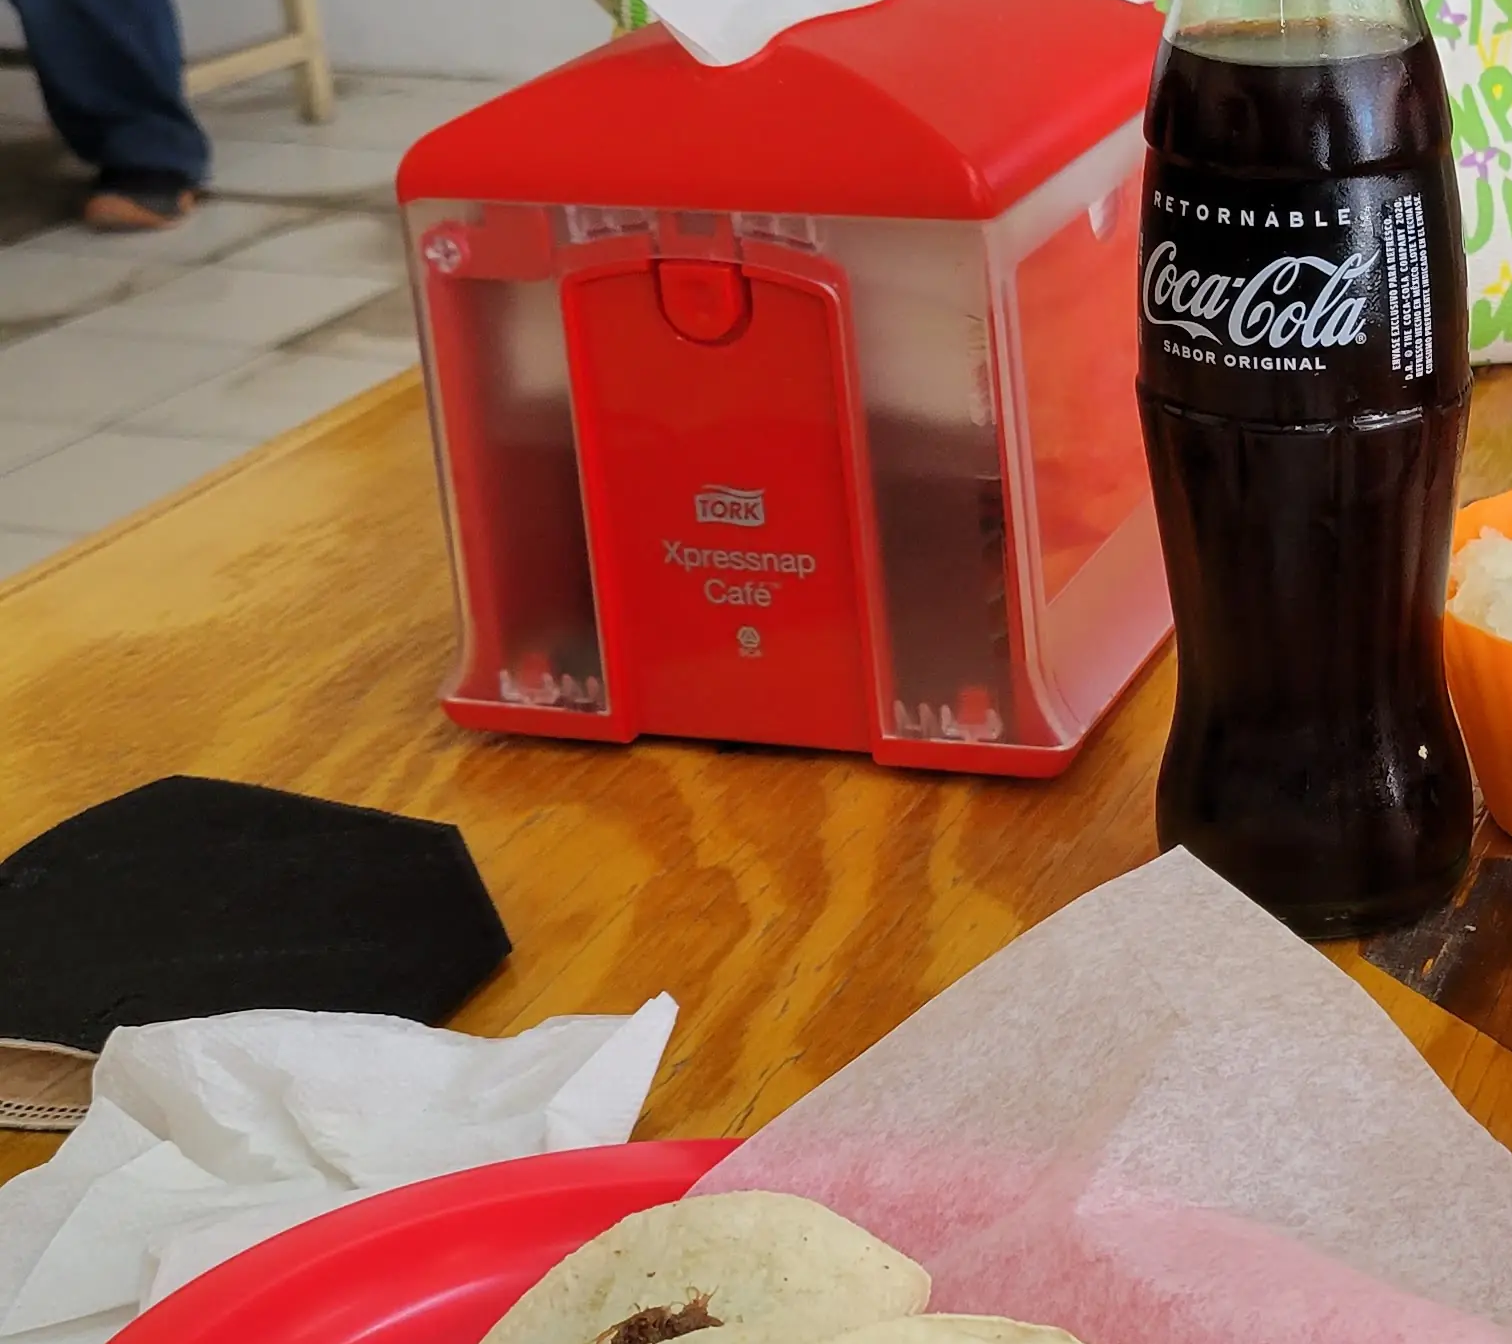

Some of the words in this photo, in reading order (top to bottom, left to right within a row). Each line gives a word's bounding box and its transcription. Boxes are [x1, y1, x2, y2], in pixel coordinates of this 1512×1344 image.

[1153, 190, 1351, 229] RETORNABLE
[1403, 194, 1412, 207] DE
[1404, 208, 1415, 234] FECHA
[1416, 226, 1425, 236] EL
[1396, 227, 1408, 272] COMPANY
[1407, 242, 1418, 262] LOTE
[1417, 237, 1426, 248] EN
[1385, 264, 1397, 287] PARA
[1408, 262, 1421, 296] MÉXICO.
[1418, 249, 1430, 288] INDICADO
[1143, 241, 1380, 349] Coca-Cola
[1399, 276, 1412, 325] COCA-COLA
[1411, 297, 1421, 309] EN
[1387, 289, 1401, 336] EXCLUSIVO
[1411, 310, 1422, 336] HECHO
[1390, 337, 1402, 370] ENVASE
[1403, 328, 1413, 347] THE
[1163, 339, 1216, 365] SABOR
[1224, 355, 1327, 371] ORIGINAL
[1404, 360, 1414, 380] D.R.
[1413, 337, 1424, 376] REFRESCO
[1423, 336, 1434, 374] CONSUMO
[698, 499, 761, 521] TORK
[661, 539, 816, 579] Xpressnap
